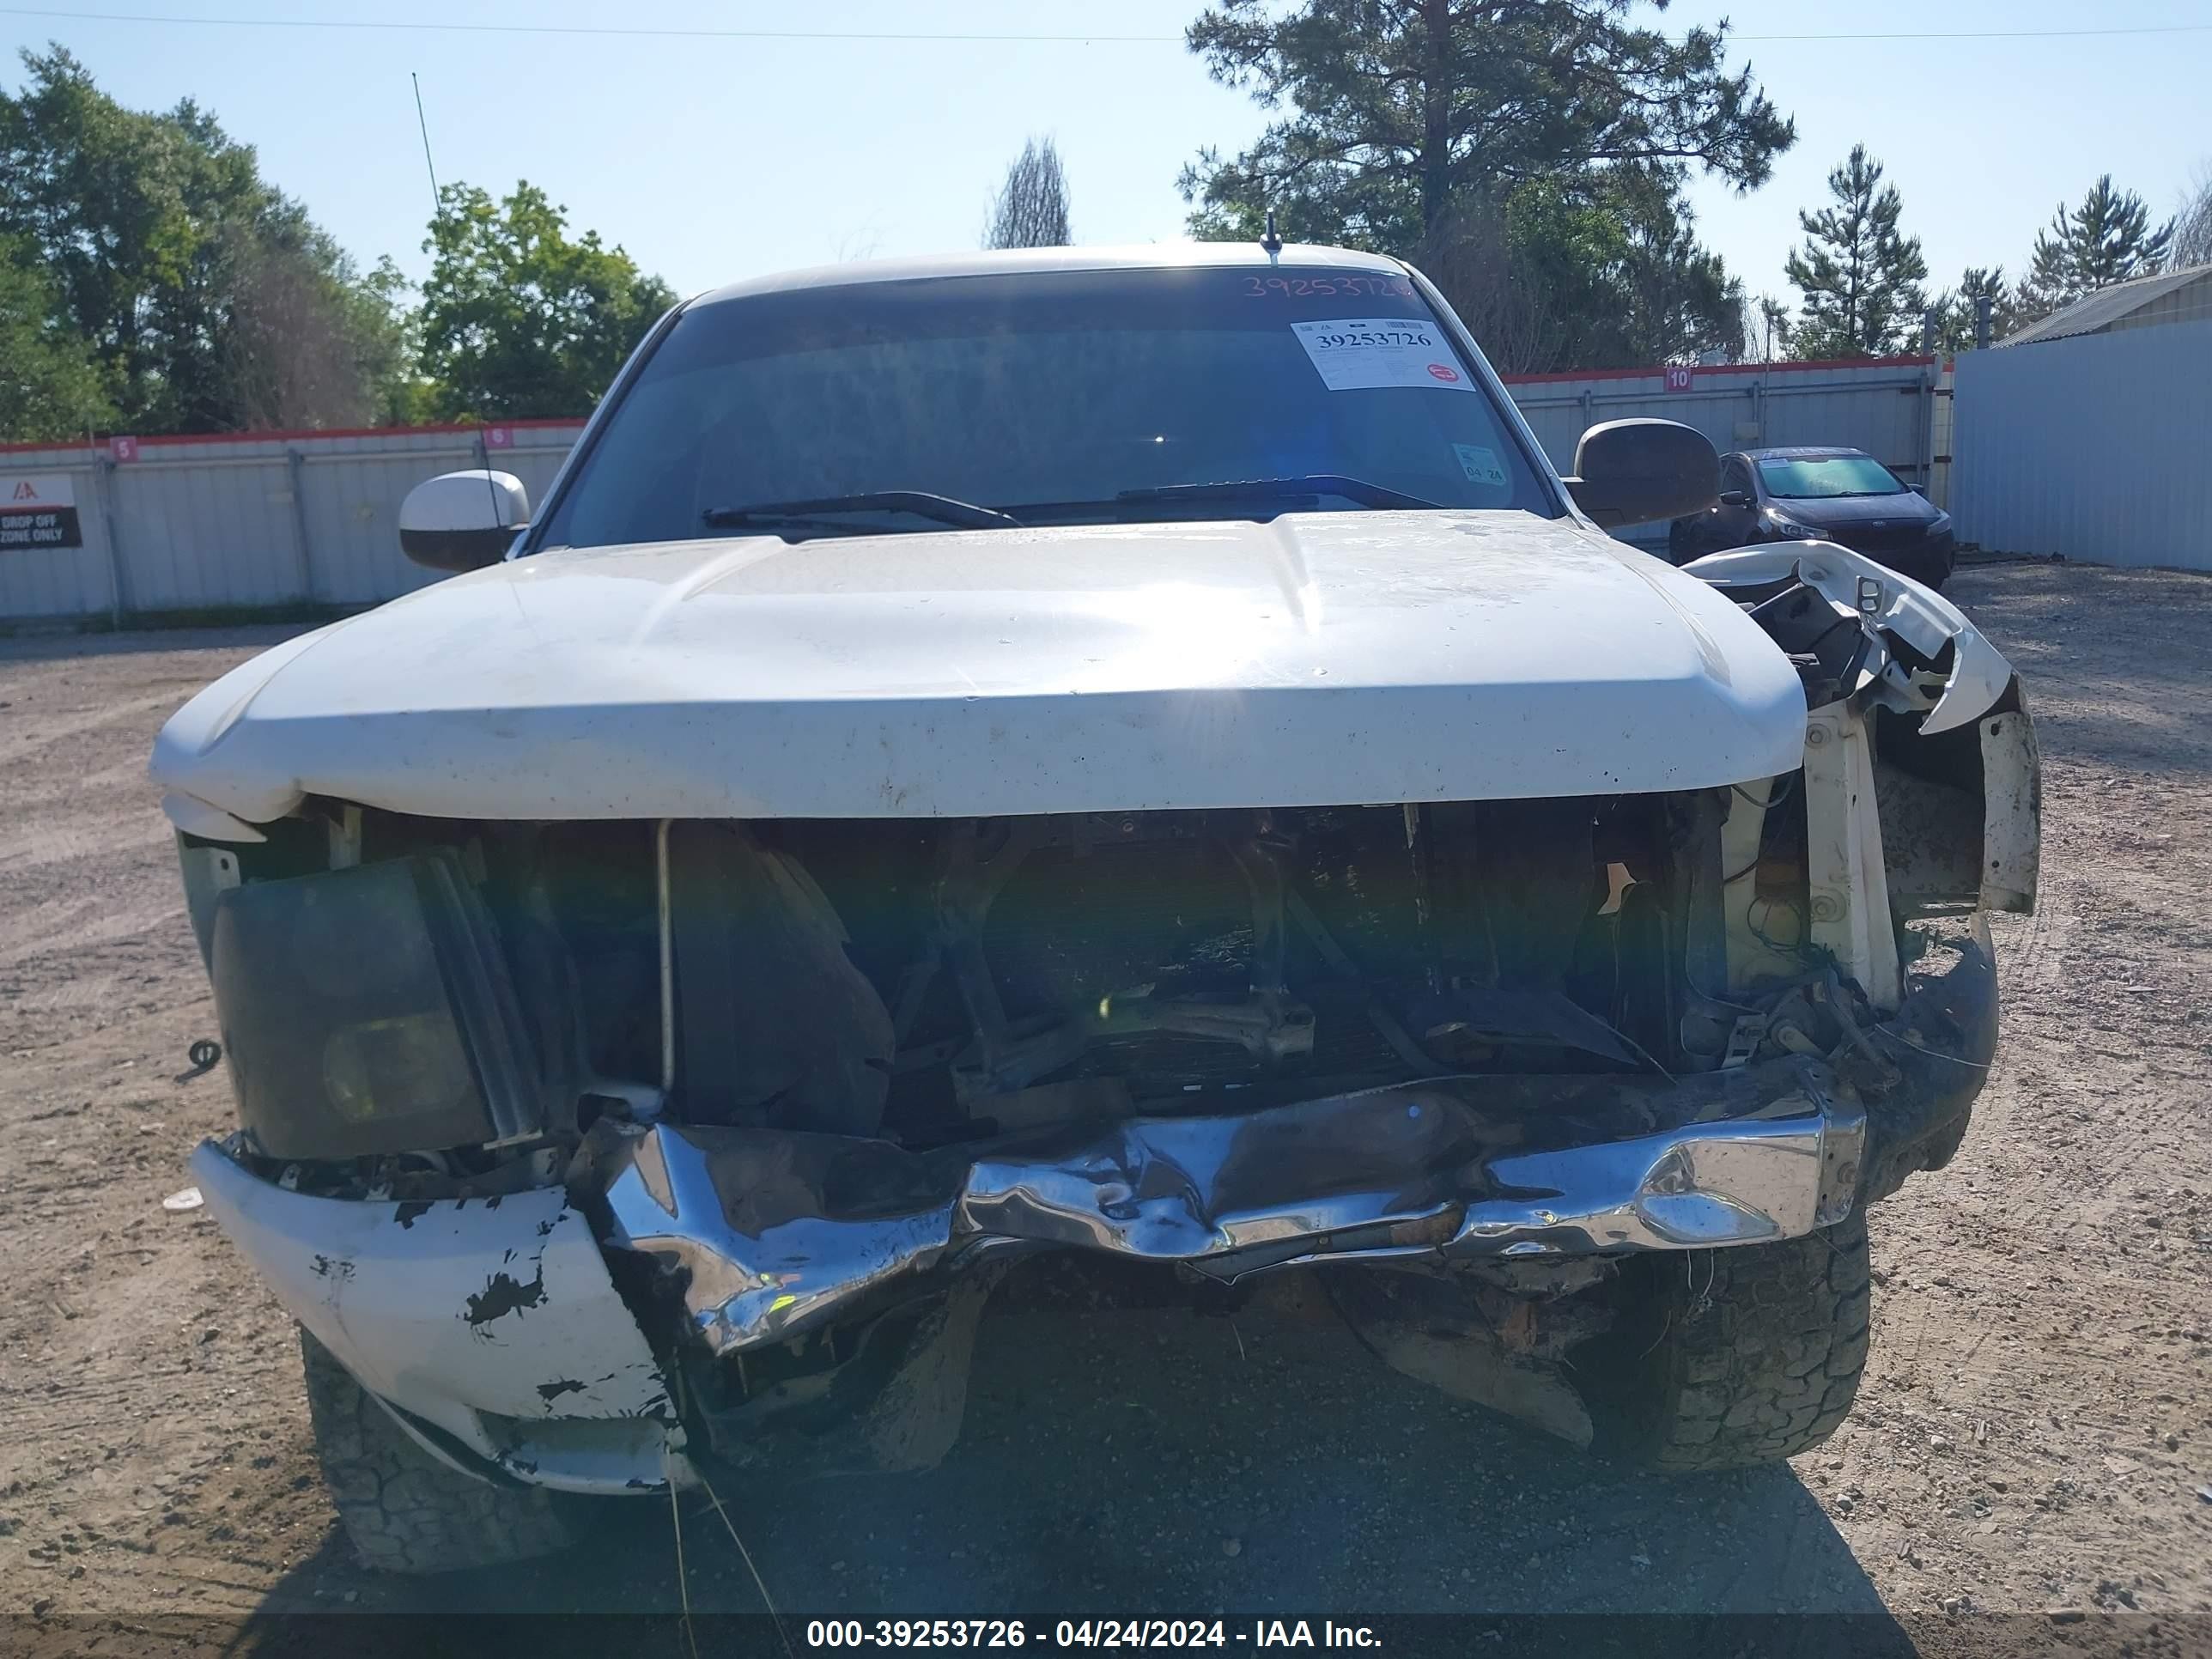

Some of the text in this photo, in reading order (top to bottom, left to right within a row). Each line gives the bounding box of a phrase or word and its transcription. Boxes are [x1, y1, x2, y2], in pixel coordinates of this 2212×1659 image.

[1316, 332, 1432, 349] 39253726
[1670, 371, 1688, 387] 10
[118, 441, 130, 459] 5
[1, 514, 56, 530] DROP OFF
[0, 528, 63, 544] ZONE ONLY
